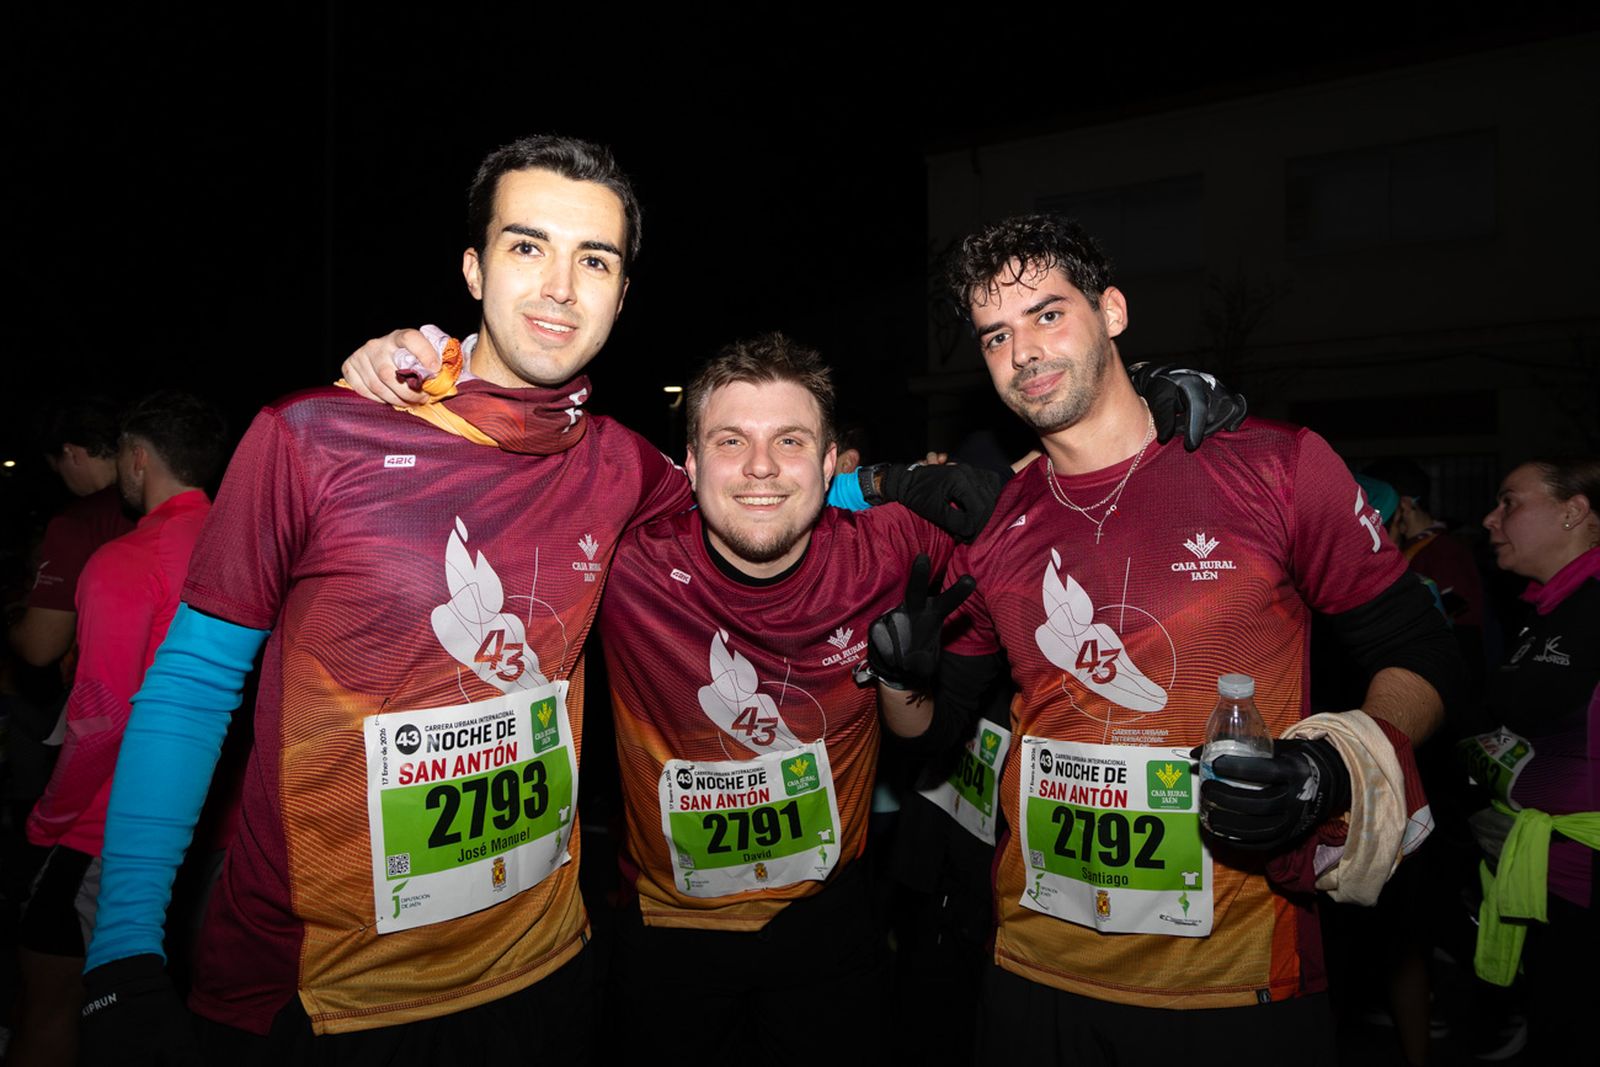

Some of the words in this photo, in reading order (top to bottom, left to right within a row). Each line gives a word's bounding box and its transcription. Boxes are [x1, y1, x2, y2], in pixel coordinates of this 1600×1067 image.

[1171, 562, 1197, 572] CAJA
[1200, 560, 1237, 570] RURAL
[1191, 570, 1218, 581] JAÉN
[474, 629, 524, 682] 43
[822, 654, 842, 666] CAJA
[843, 641, 868, 658] RURAL
[1074, 639, 1121, 684] 43
[425, 721, 453, 732] CARRERA
[454, 718, 477, 728] URBANA
[478, 710, 514, 725] INTERNACIONAL
[731, 707, 778, 746] 43
[396, 731, 418, 747] 43
[427, 723, 491, 753] NOCHE
[496, 718, 516, 740] DE
[399, 758, 446, 785] SAN
[452, 740, 517, 777] ANTÓN
[1040, 755, 1052, 768] 43
[1055, 761, 1099, 783] NOCHE
[1104, 767, 1127, 784] DE
[1088, 758, 1126, 766] INTERNACIONAL
[678, 773, 692, 784] 43
[696, 776, 744, 790] NOCHE
[748, 771, 767, 787] DE
[425, 760, 549, 849] 2793
[680, 795, 711, 810] SAN
[716, 788, 769, 809] ANTÓN
[1039, 779, 1067, 801] SAN
[1069, 784, 1128, 808] ANTÓN
[703, 800, 803, 855] 2791
[1052, 805, 1165, 869] 2792
[458, 842, 487, 863] José
[491, 827, 530, 854] Manuel
[743, 850, 772, 862] David
[1082, 867, 1129, 887] Santiago
